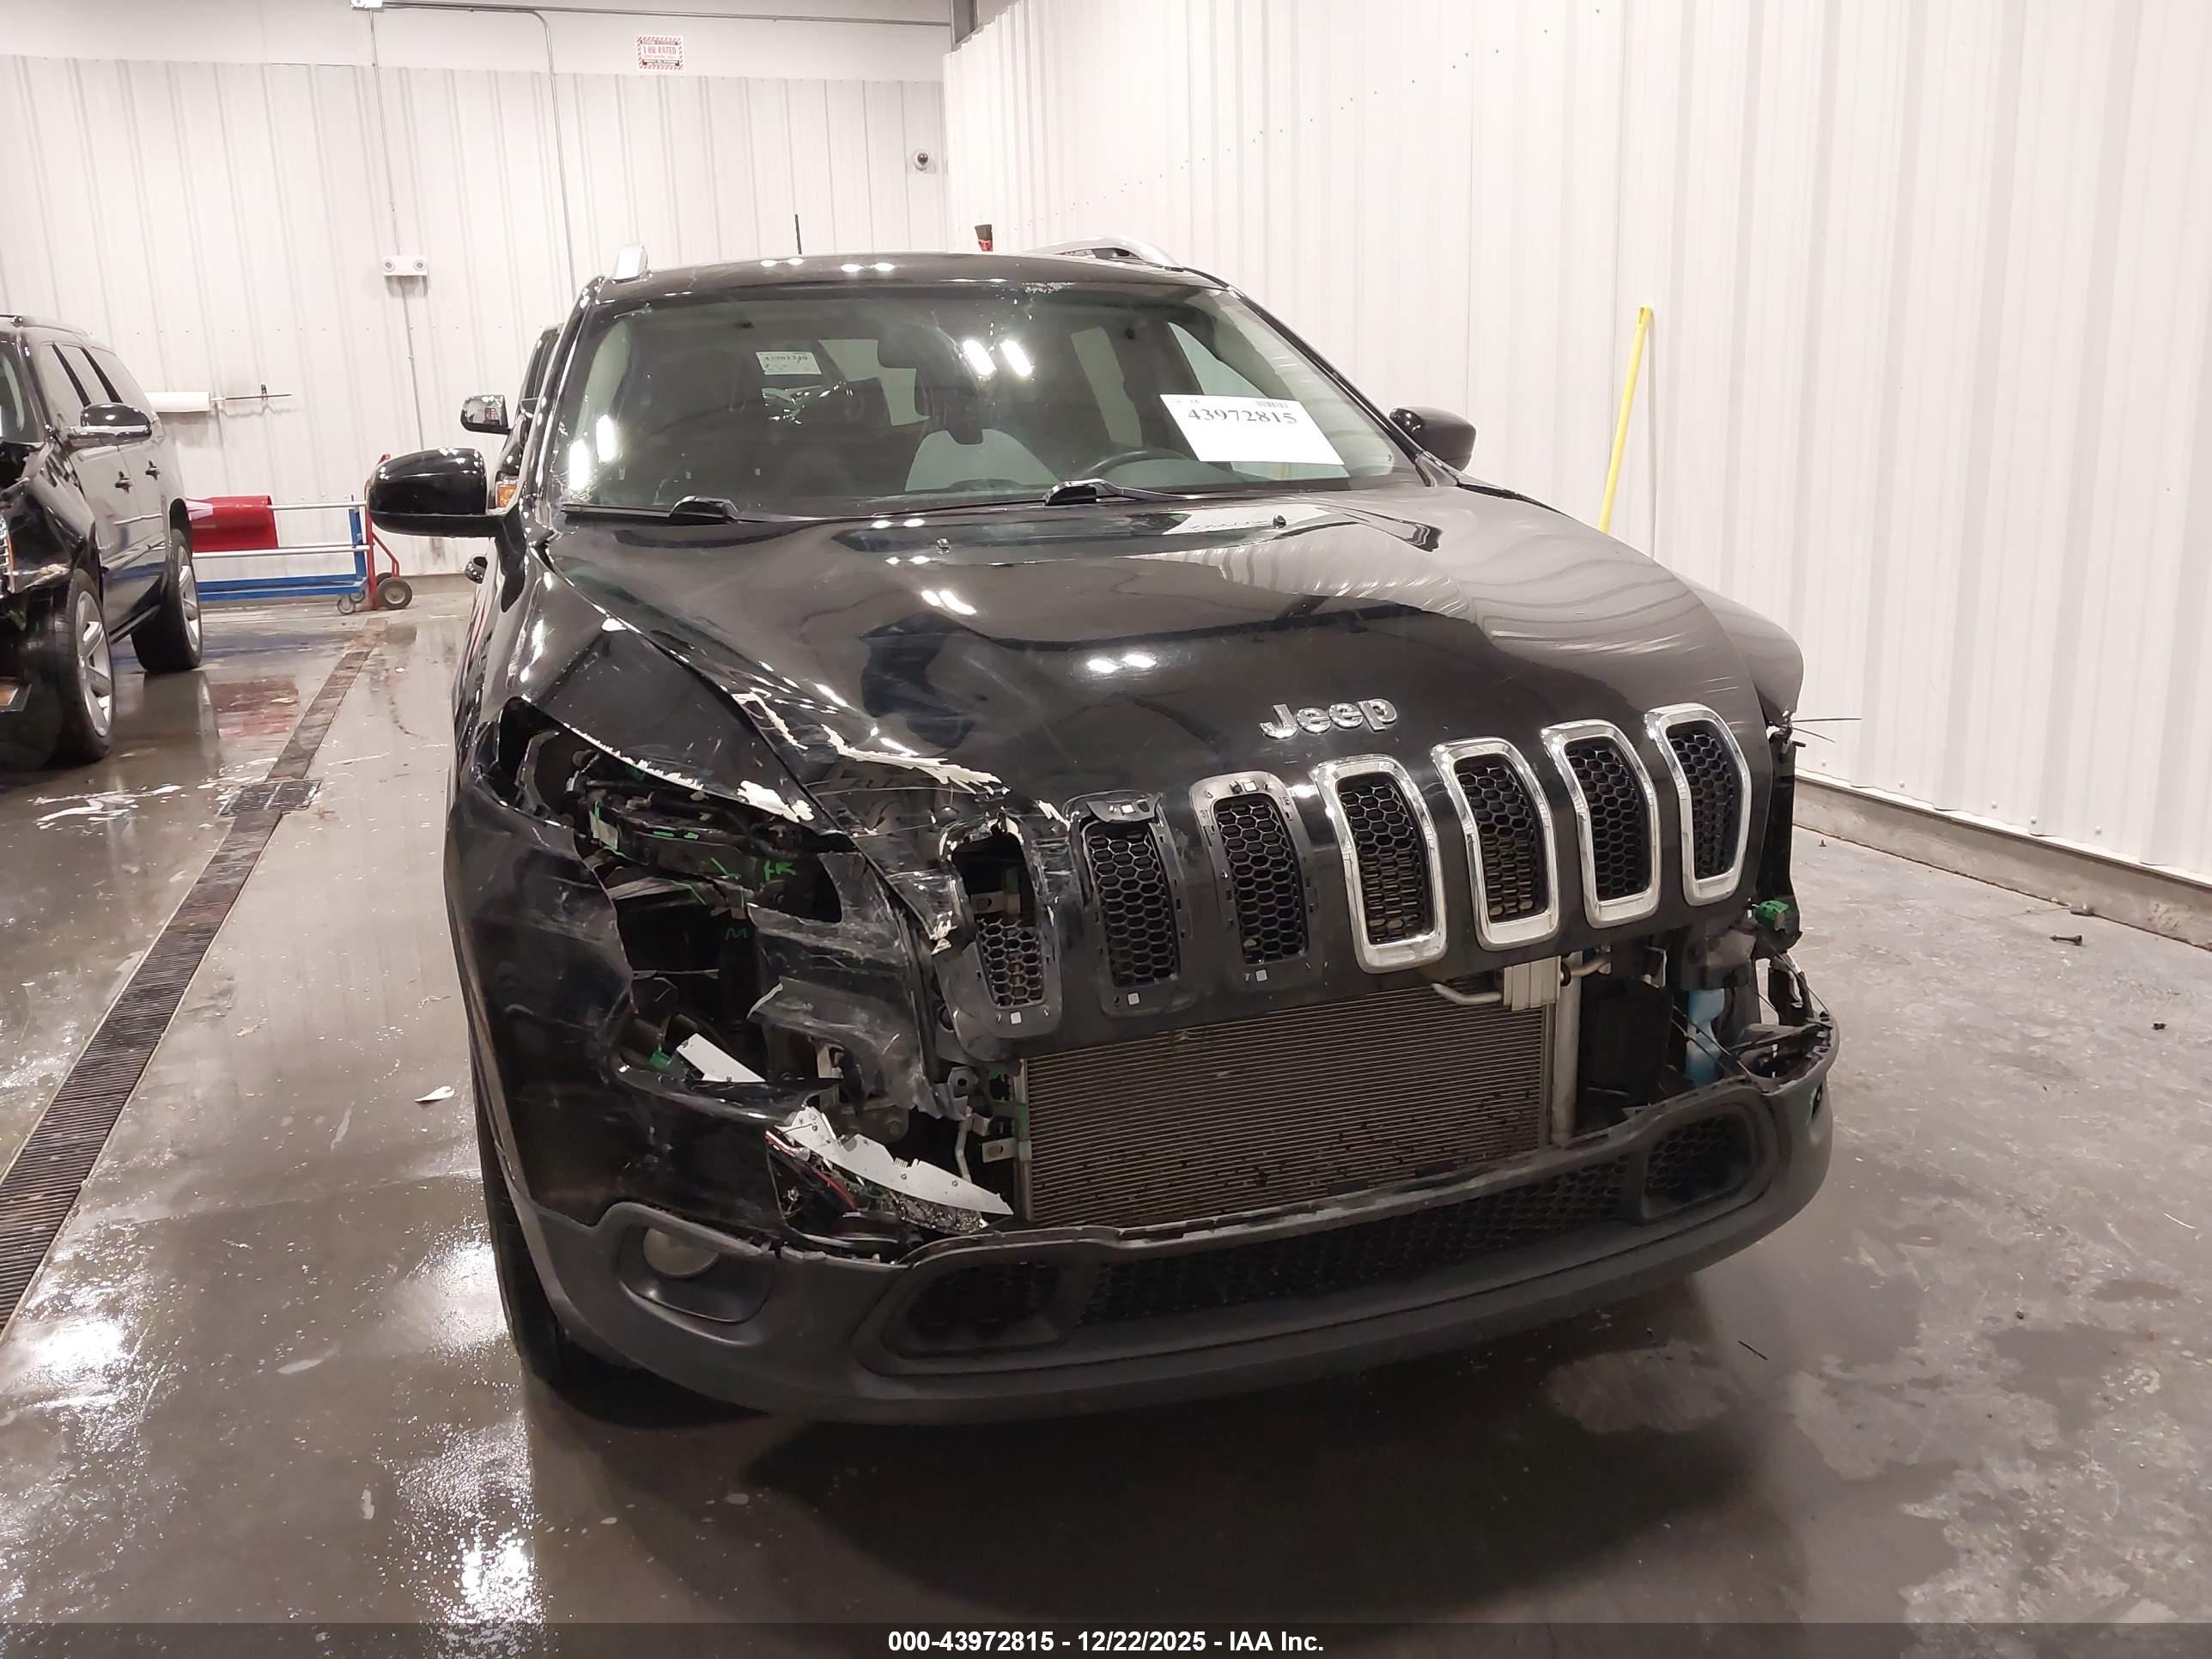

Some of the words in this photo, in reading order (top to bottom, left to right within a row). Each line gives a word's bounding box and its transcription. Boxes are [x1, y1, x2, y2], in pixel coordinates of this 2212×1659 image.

[659, 46, 677, 55] RATED
[1188, 408, 1297, 424] 43972815
[1259, 698, 1397, 739] Jeep
